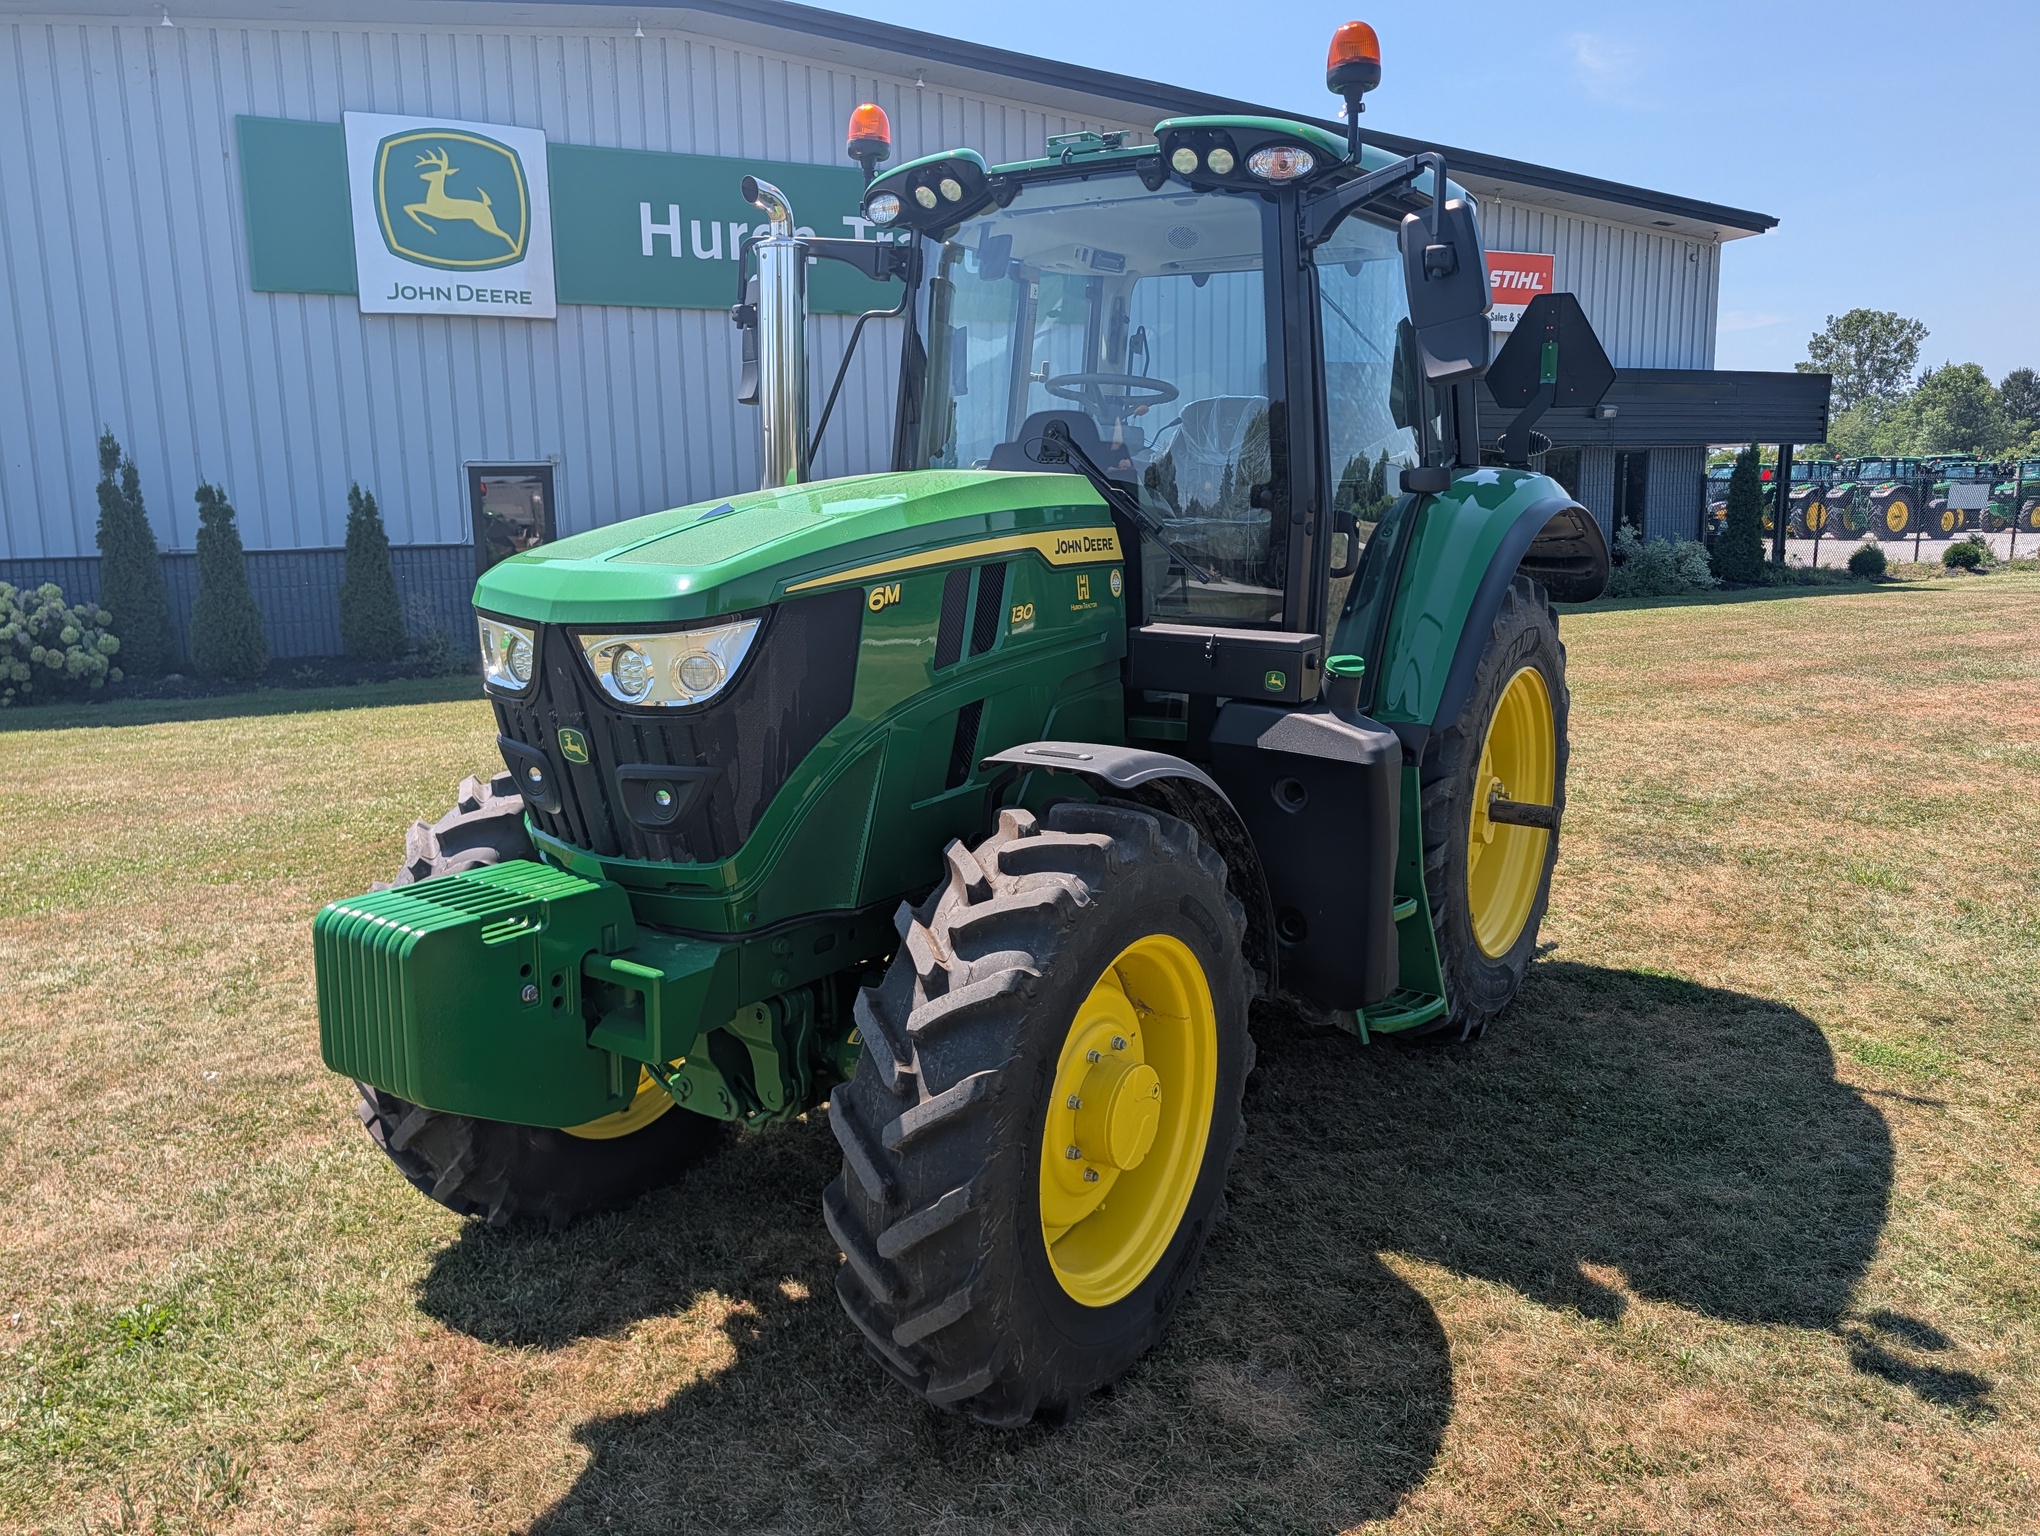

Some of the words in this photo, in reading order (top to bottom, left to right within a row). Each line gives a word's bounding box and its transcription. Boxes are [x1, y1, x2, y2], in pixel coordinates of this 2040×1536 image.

[1490, 270, 1544, 290] STIHL
[387, 282, 452, 301] JOHN
[456, 284, 533, 305] DEERE
[1490, 312, 1507, 322] Sales
[1509, 312, 1515, 322] &
[1055, 538, 1082, 555] JOHN
[1083, 536, 1114, 552] DEERE
[869, 583, 901, 611] 6M
[1011, 603, 1034, 623] 130
